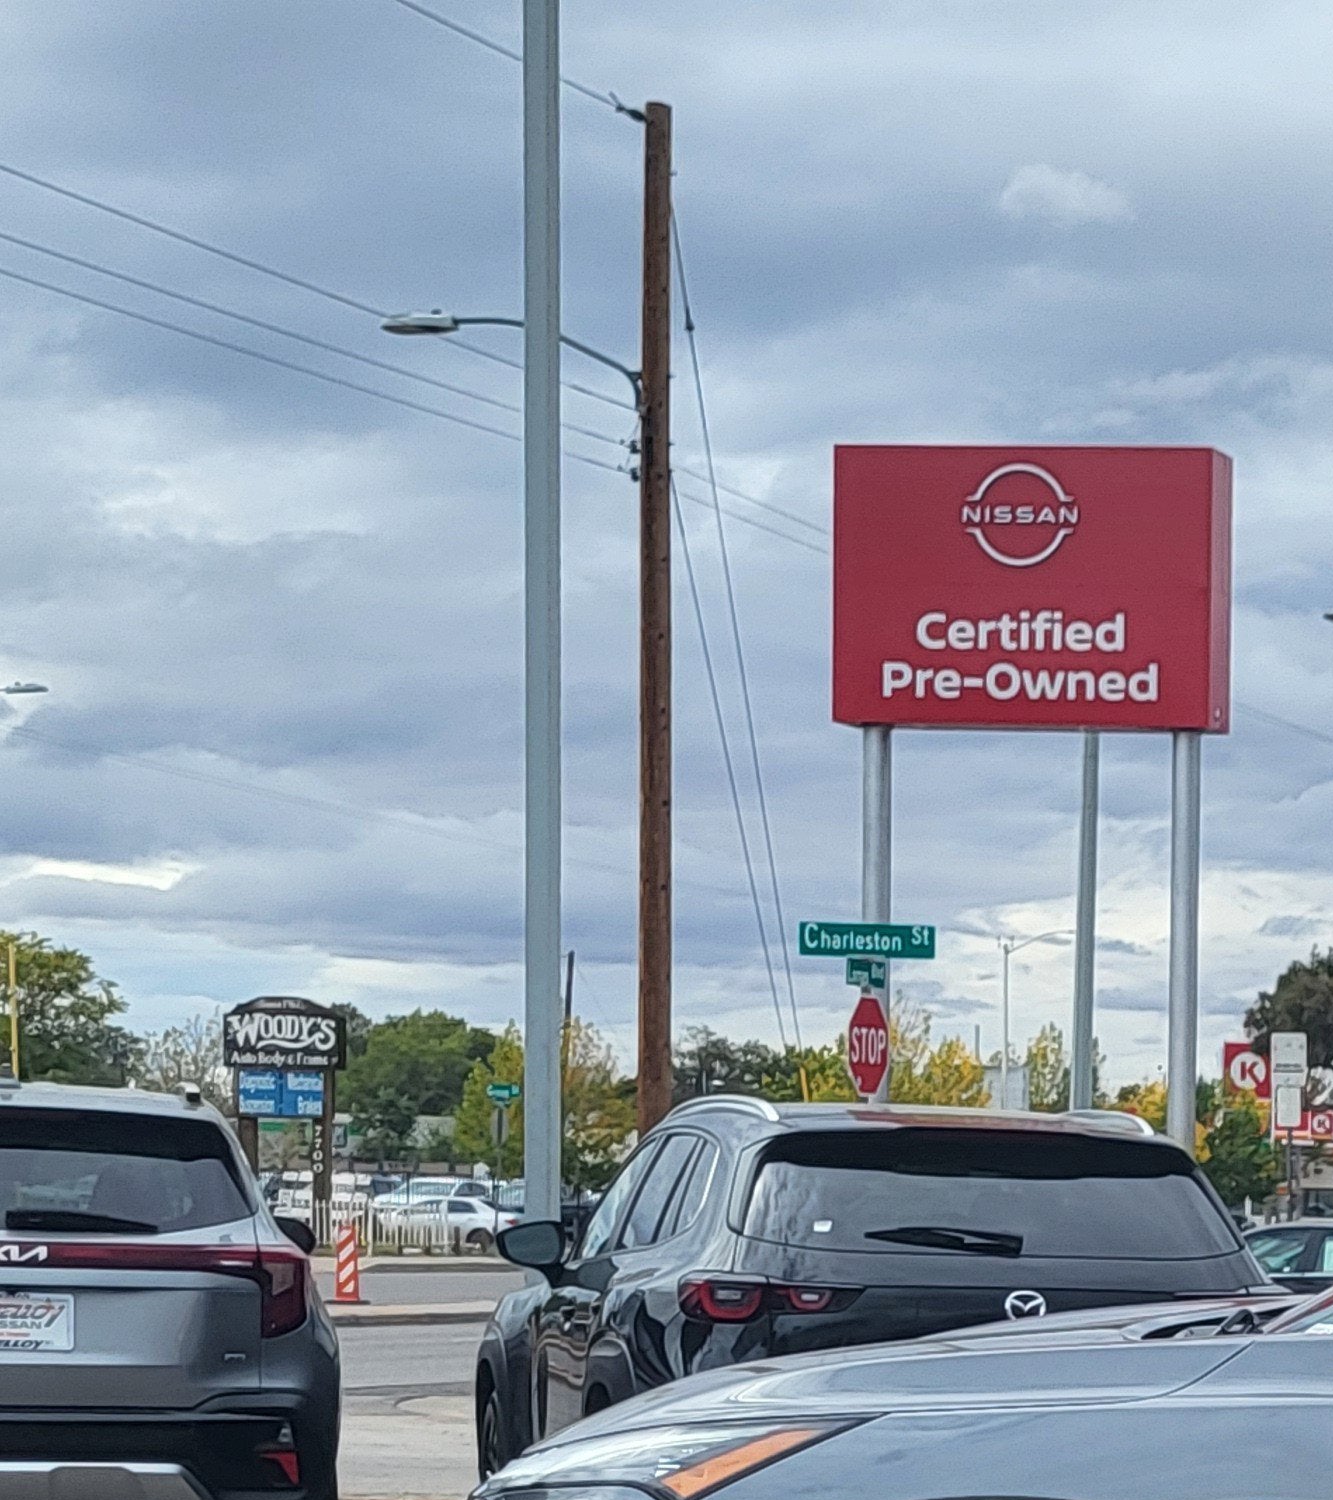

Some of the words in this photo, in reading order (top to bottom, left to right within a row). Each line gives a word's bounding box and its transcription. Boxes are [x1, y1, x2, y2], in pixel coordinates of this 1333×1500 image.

[961, 505, 1079, 524] NISSAN
[916, 610, 1126, 652] Certified
[881, 660, 1159, 702] Pre-Owned
[803, 922, 902, 952] Charleston
[911, 925, 930, 946] St
[230, 1050, 257, 1064] Auto
[258, 1050, 286, 1068] Body
[850, 1026, 887, 1065] STOP
[312, 1125, 324, 1174] 7700
